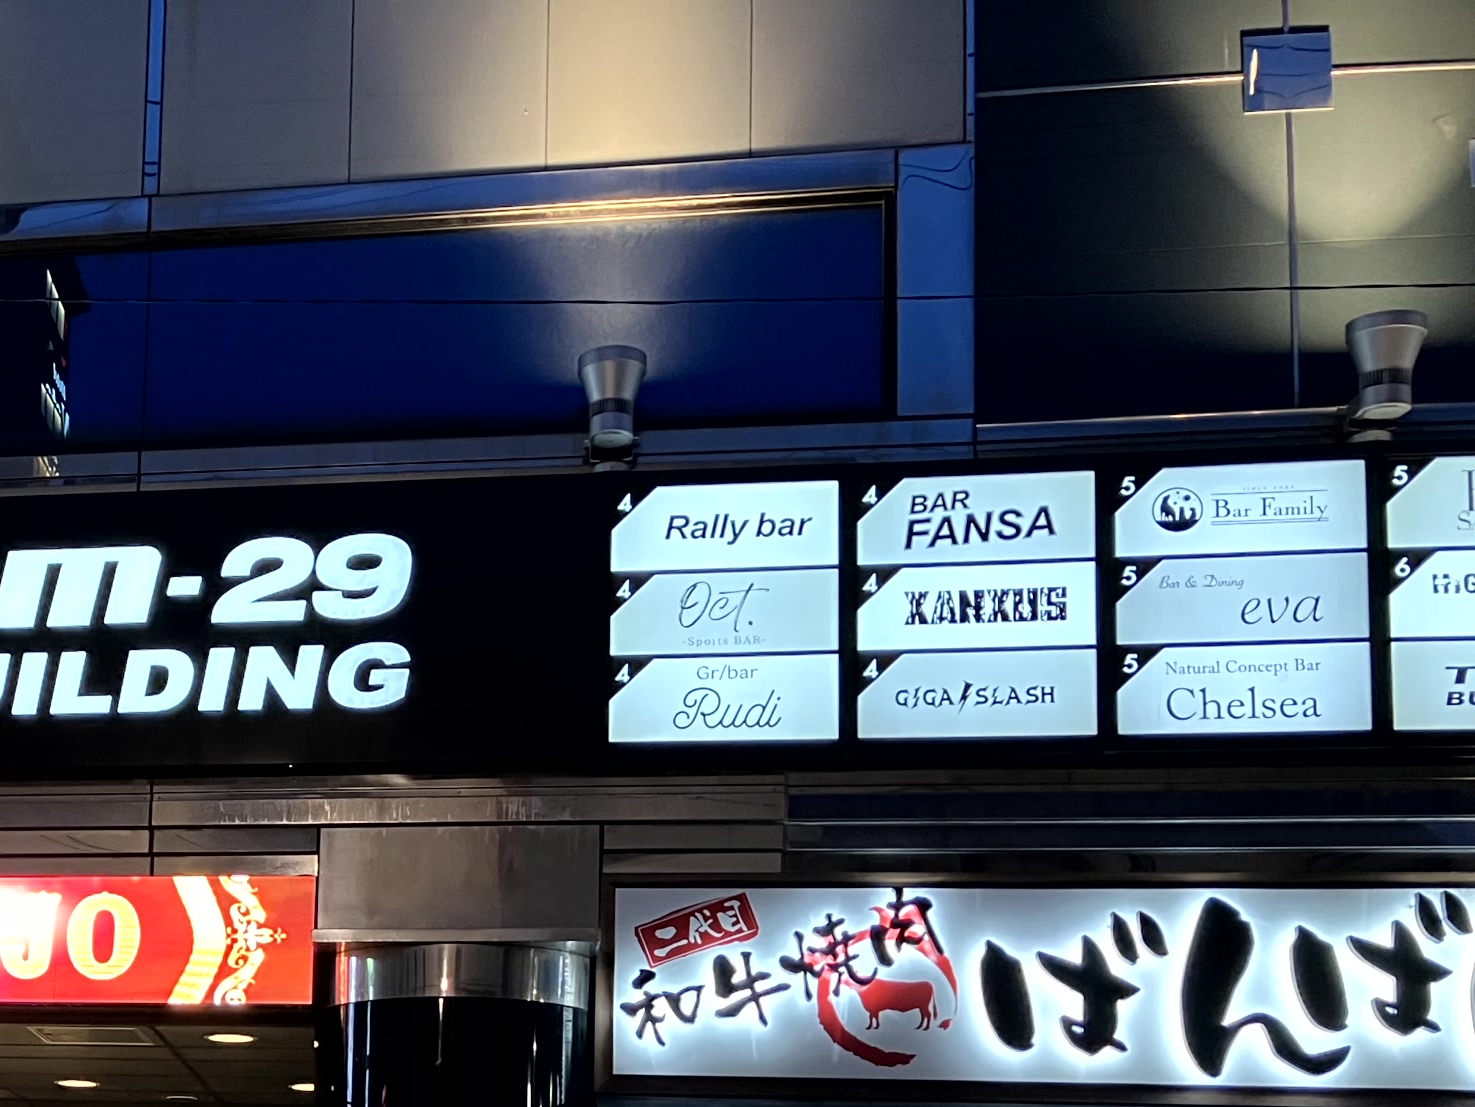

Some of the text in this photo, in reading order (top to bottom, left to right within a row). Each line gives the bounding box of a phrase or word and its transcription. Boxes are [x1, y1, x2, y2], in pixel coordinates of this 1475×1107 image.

[1392, 465, 1408, 485] 5
[862, 485, 878, 504] 4
[1120, 476, 1136, 497] 5
[617, 493, 632, 512] 4
[910, 490, 970, 514] BAR
[1211, 495, 1328, 521] Bar Family
[665, 512, 813, 545] Rally bar
[904, 505, 1057, 550] FANSA
[1121, 566, 1137, 586] 5
[1395, 557, 1411, 577] 6
[616, 580, 631, 599] 4
[862, 573, 878, 592] 4
[1159, 574, 1244, 590] Bar & Dining
[679, 581, 770, 632] Oct.
[904, 587, 1067, 626] XANXUS
[1240, 595, 1324, 625] eva
[615, 664, 630, 683] 4
[696, 665, 758, 682] Gr/bar
[863, 660, 879, 679] 4
[1122, 654, 1139, 674] 5
[1165, 658, 1322, 676] Natural Concept Bar
[673, 687, 781, 730] Rudi
[1166, 686, 1322, 720] Chelsea
[654, 900, 746, 956] 二代目
[620, 887, 945, 1046] 和牛焼肉
